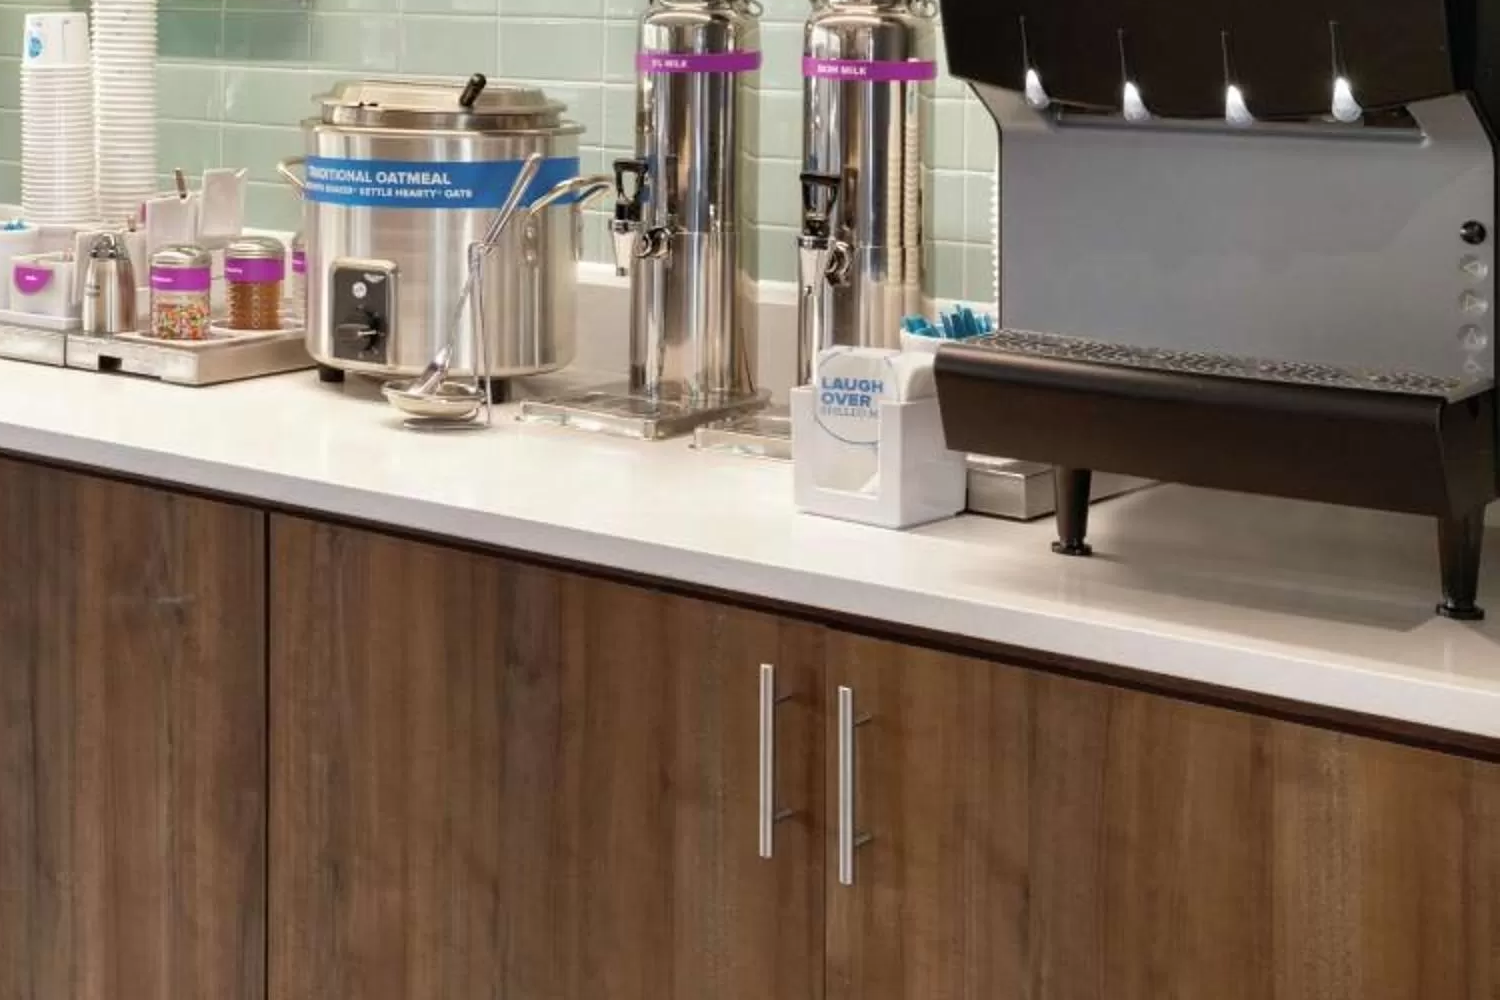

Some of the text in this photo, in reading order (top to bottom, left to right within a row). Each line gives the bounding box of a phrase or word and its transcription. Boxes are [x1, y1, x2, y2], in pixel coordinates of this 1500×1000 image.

[375, 171, 452, 186] OATMEAL
[821, 376, 884, 393] LAUGH
[821, 392, 872, 408] OVER
